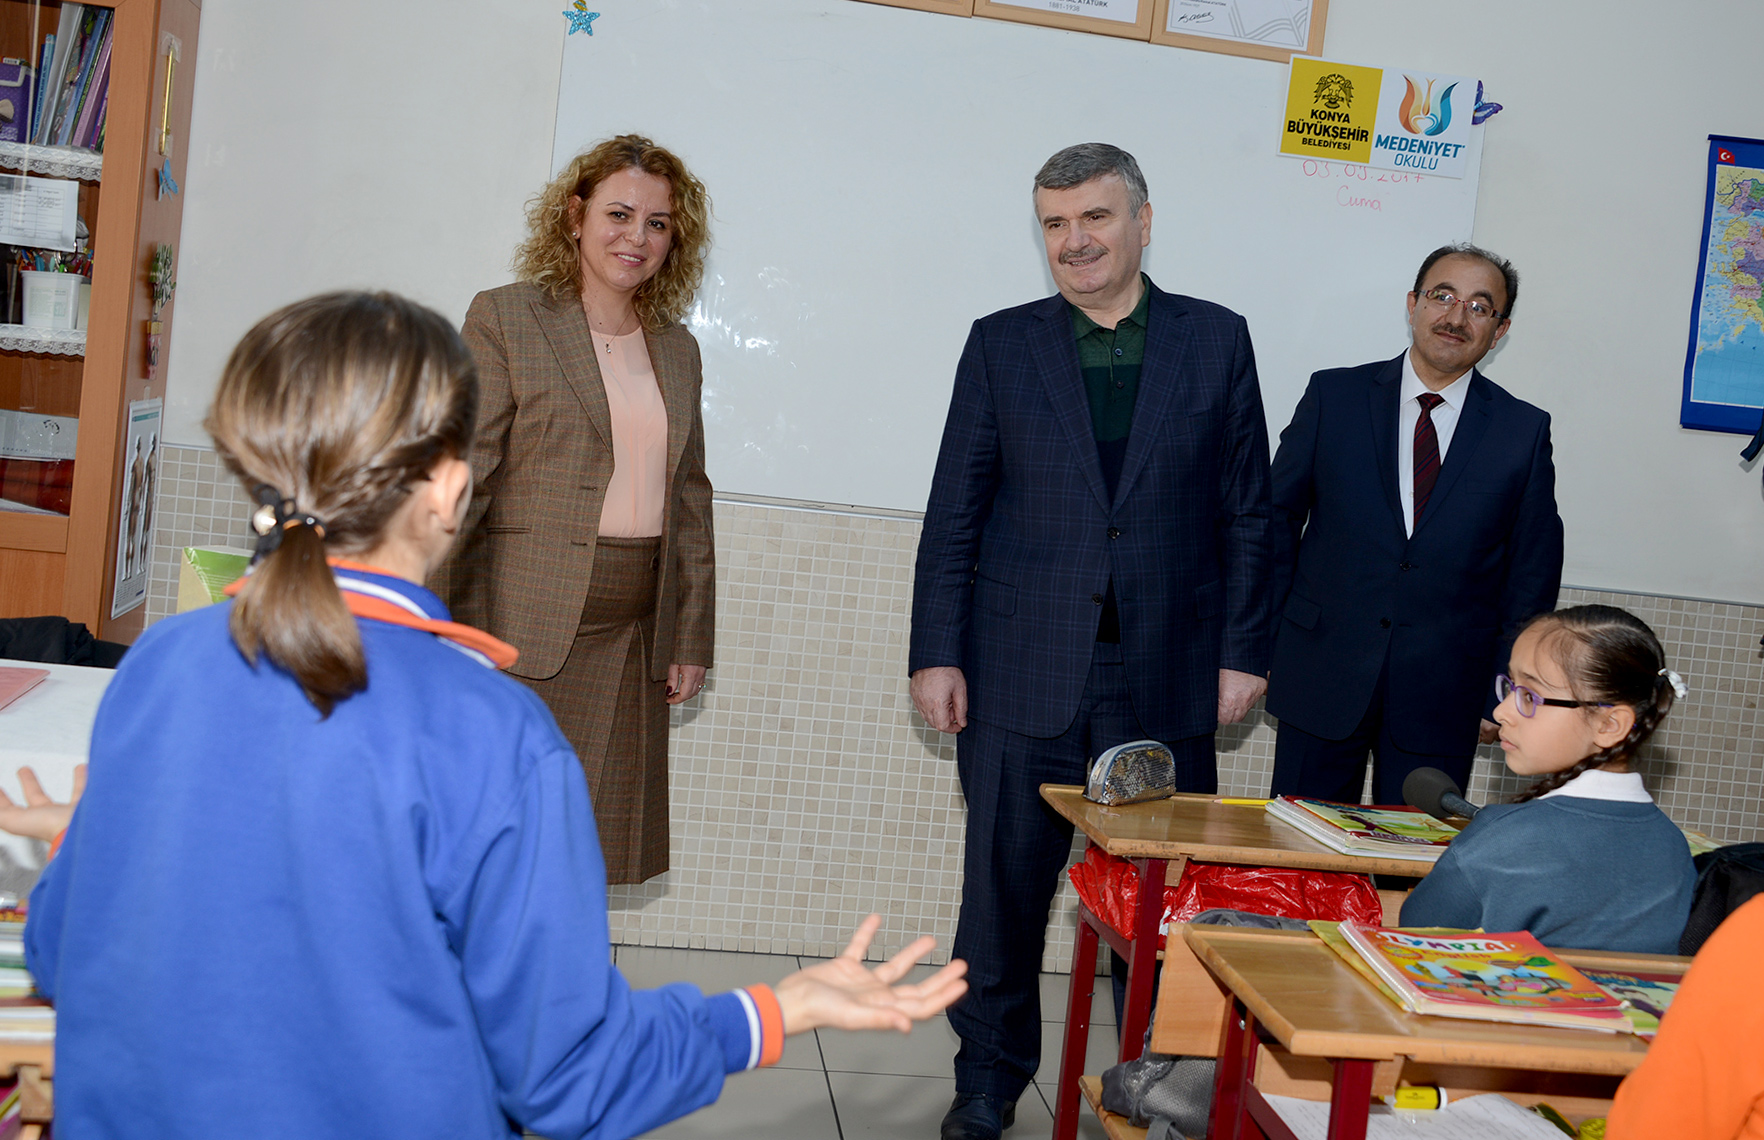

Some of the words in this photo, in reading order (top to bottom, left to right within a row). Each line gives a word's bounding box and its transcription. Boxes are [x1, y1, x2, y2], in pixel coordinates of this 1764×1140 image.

[1310, 109, 1351, 124] KONYA
[1287, 118, 1369, 143] BÜYÜKŞEHİR
[1301, 137, 1351, 151] BELEDİYESİ
[1393, 153, 1439, 171] OKULU
[1336, 184, 1382, 212] Cuma
